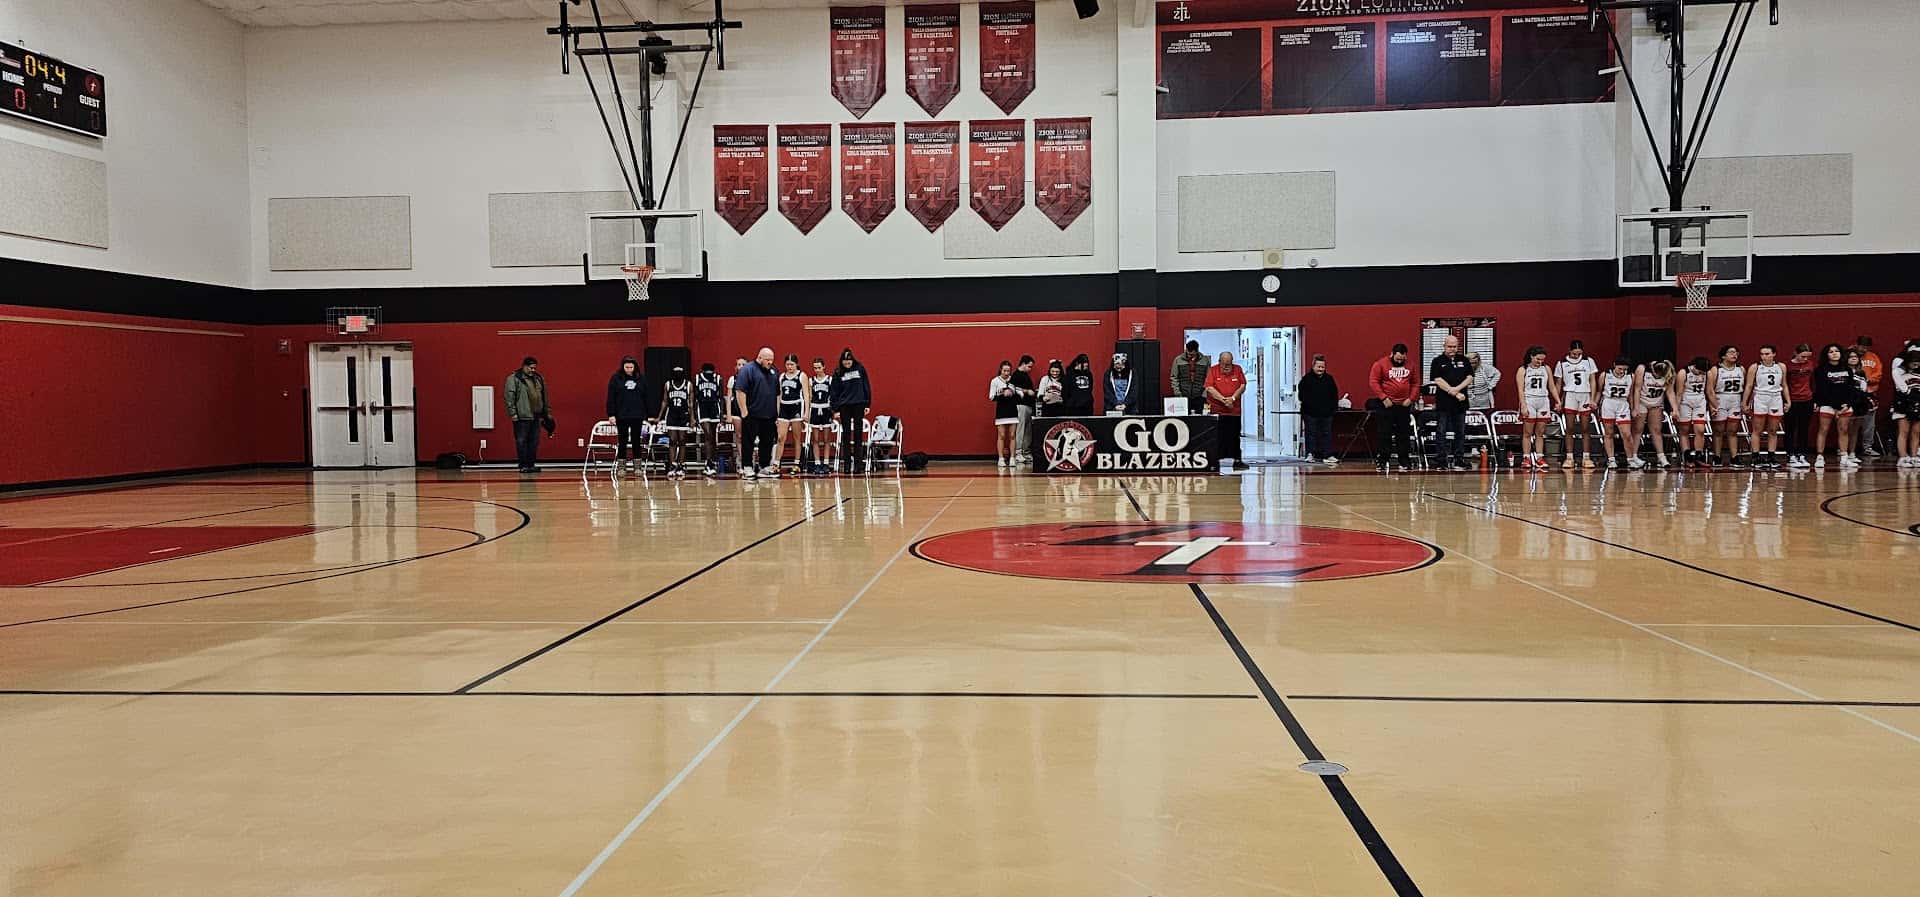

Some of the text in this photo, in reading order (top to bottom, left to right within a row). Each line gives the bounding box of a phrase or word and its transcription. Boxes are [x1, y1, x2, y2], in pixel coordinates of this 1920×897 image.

[1296, 0, 1351, 12] ZION
[2, 70, 24, 86] HOME
[43, 82, 63, 95] PERIOD
[14, 87, 26, 110] 0
[53, 97, 57, 109] 1
[79, 94, 100, 109] GUEST
[1530, 377, 1543, 389] 21
[1573, 373, 1582, 386] 5
[1724, 379, 1741, 392] 25
[1767, 375, 1775, 385] 3
[702, 389, 712, 398] 14
[784, 386, 790, 395] 2
[818, 391, 822, 400] 1
[1610, 386, 1626, 398] 22
[672, 398, 682, 407] 12
[1496, 414, 1519, 423] ZION
[1114, 418, 1190, 453] GO
[1096, 451, 1209, 470] BLAZERS
